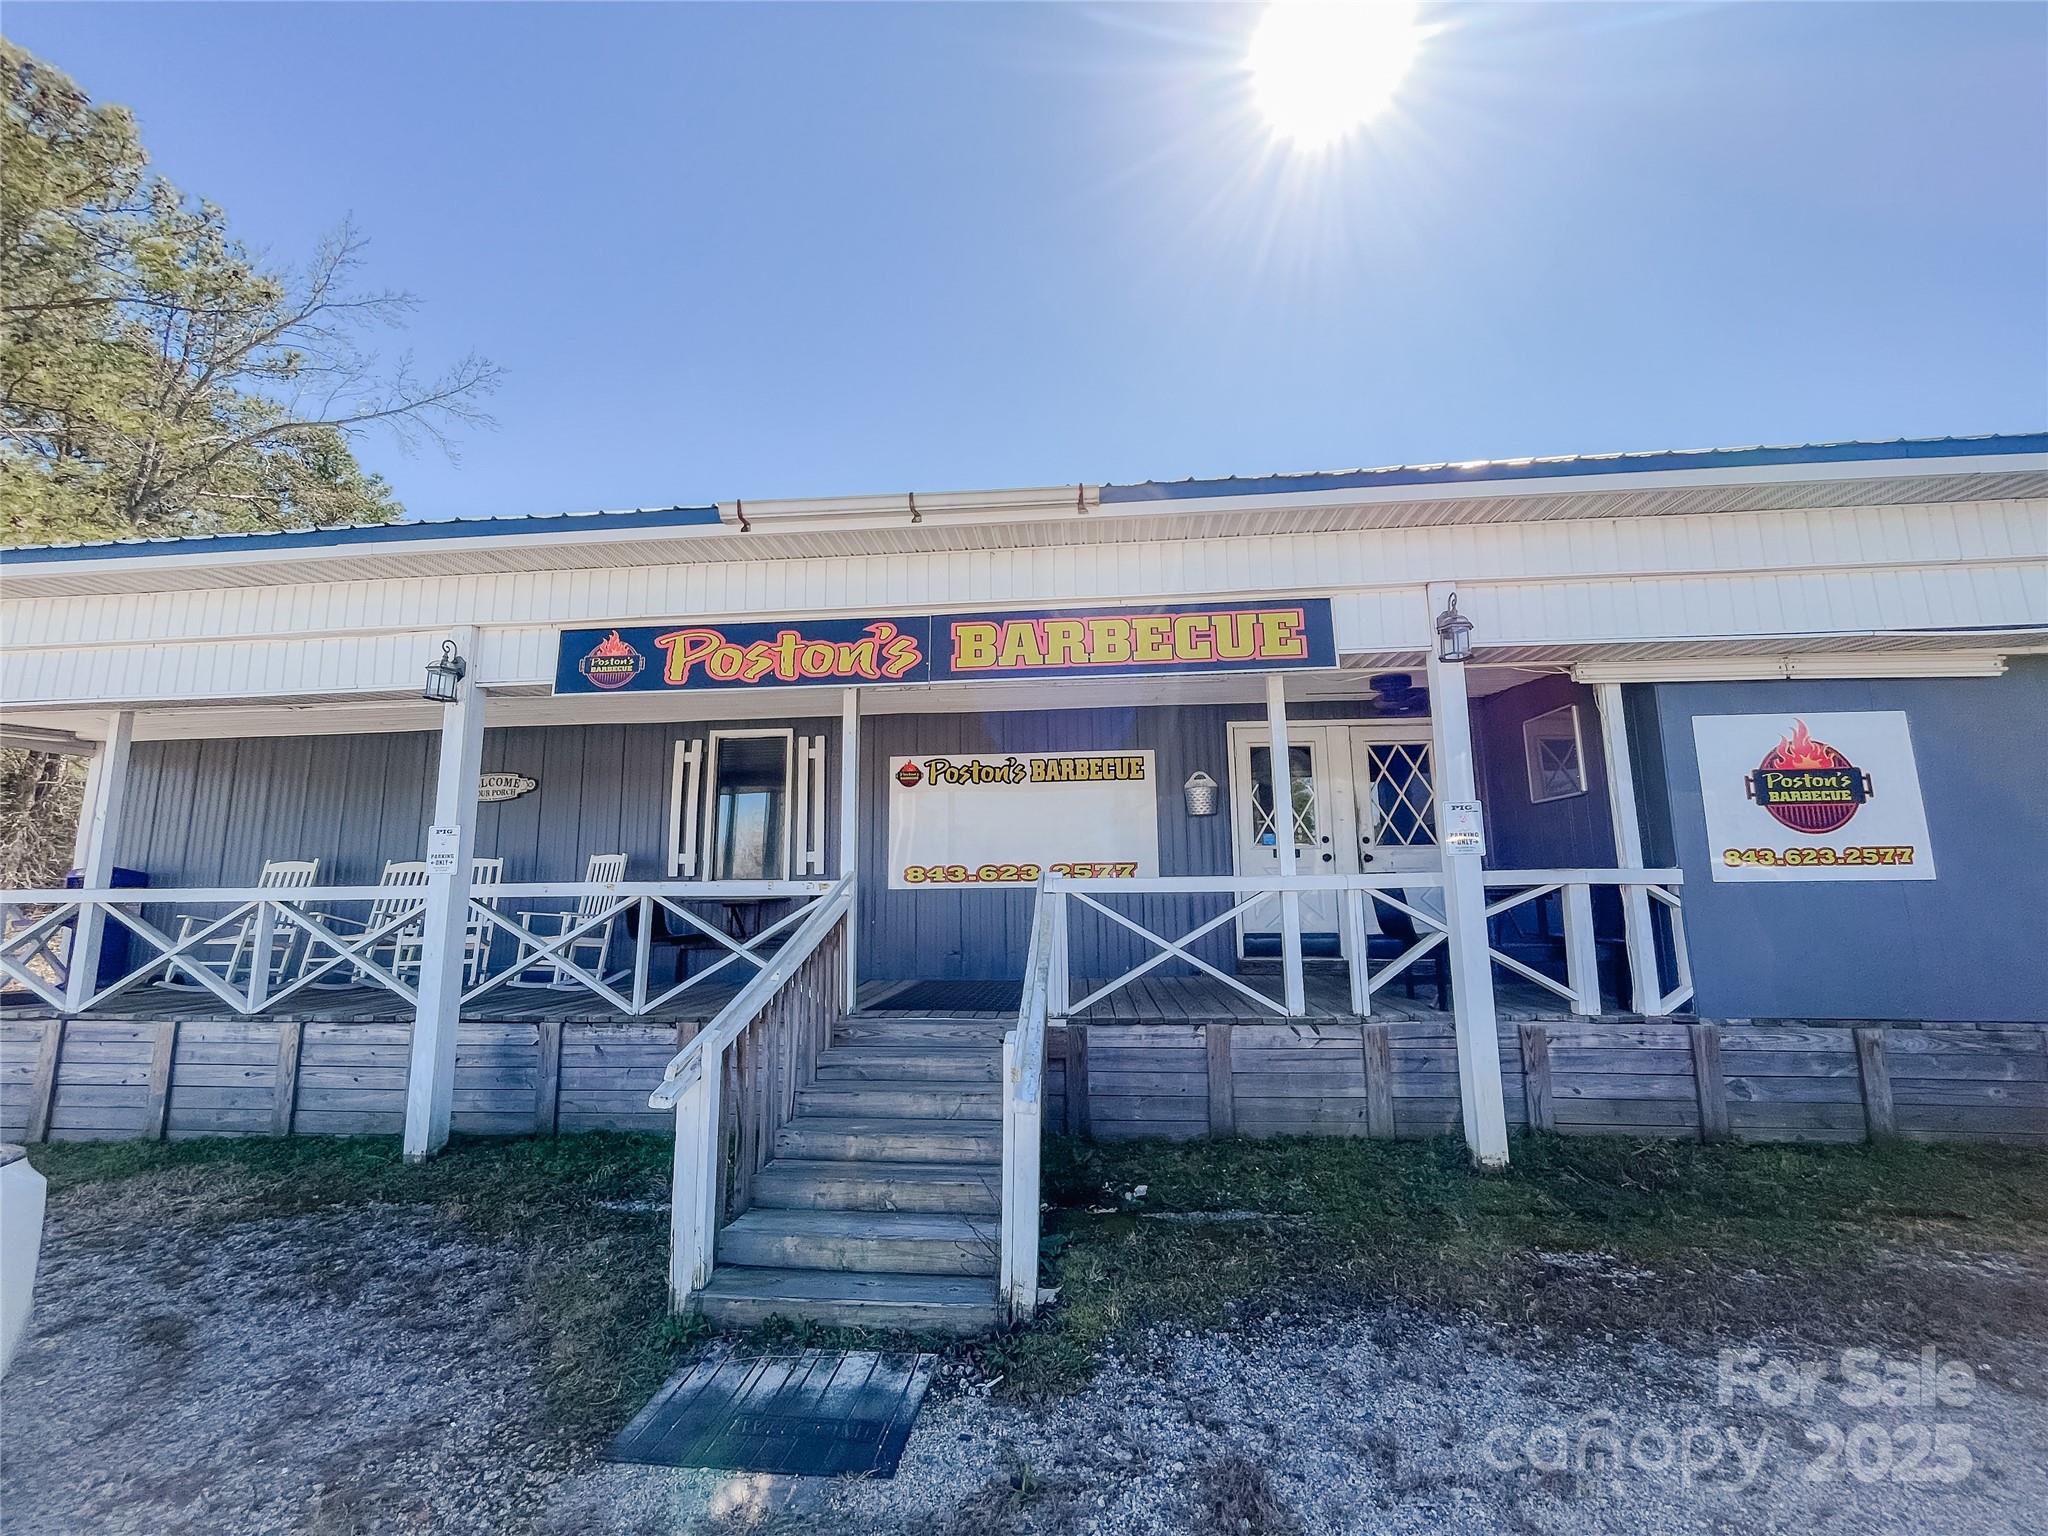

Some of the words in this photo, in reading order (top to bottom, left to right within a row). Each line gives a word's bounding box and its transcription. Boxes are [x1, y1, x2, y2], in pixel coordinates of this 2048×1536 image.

[655, 622, 922, 685] Poston's
[952, 609, 1308, 671] BARBECUE
[591, 657, 634, 666] Poston's
[924, 757, 1026, 786] Poston's
[1030, 755, 1145, 783] BARBECUE
[479, 777, 521, 788] LCOME
[1762, 771, 1852, 789] Poston's
[491, 788, 516, 797] PORCH
[1769, 789, 1852, 802] BARBECUE
[1722, 846, 1914, 868] 843.623.2577
